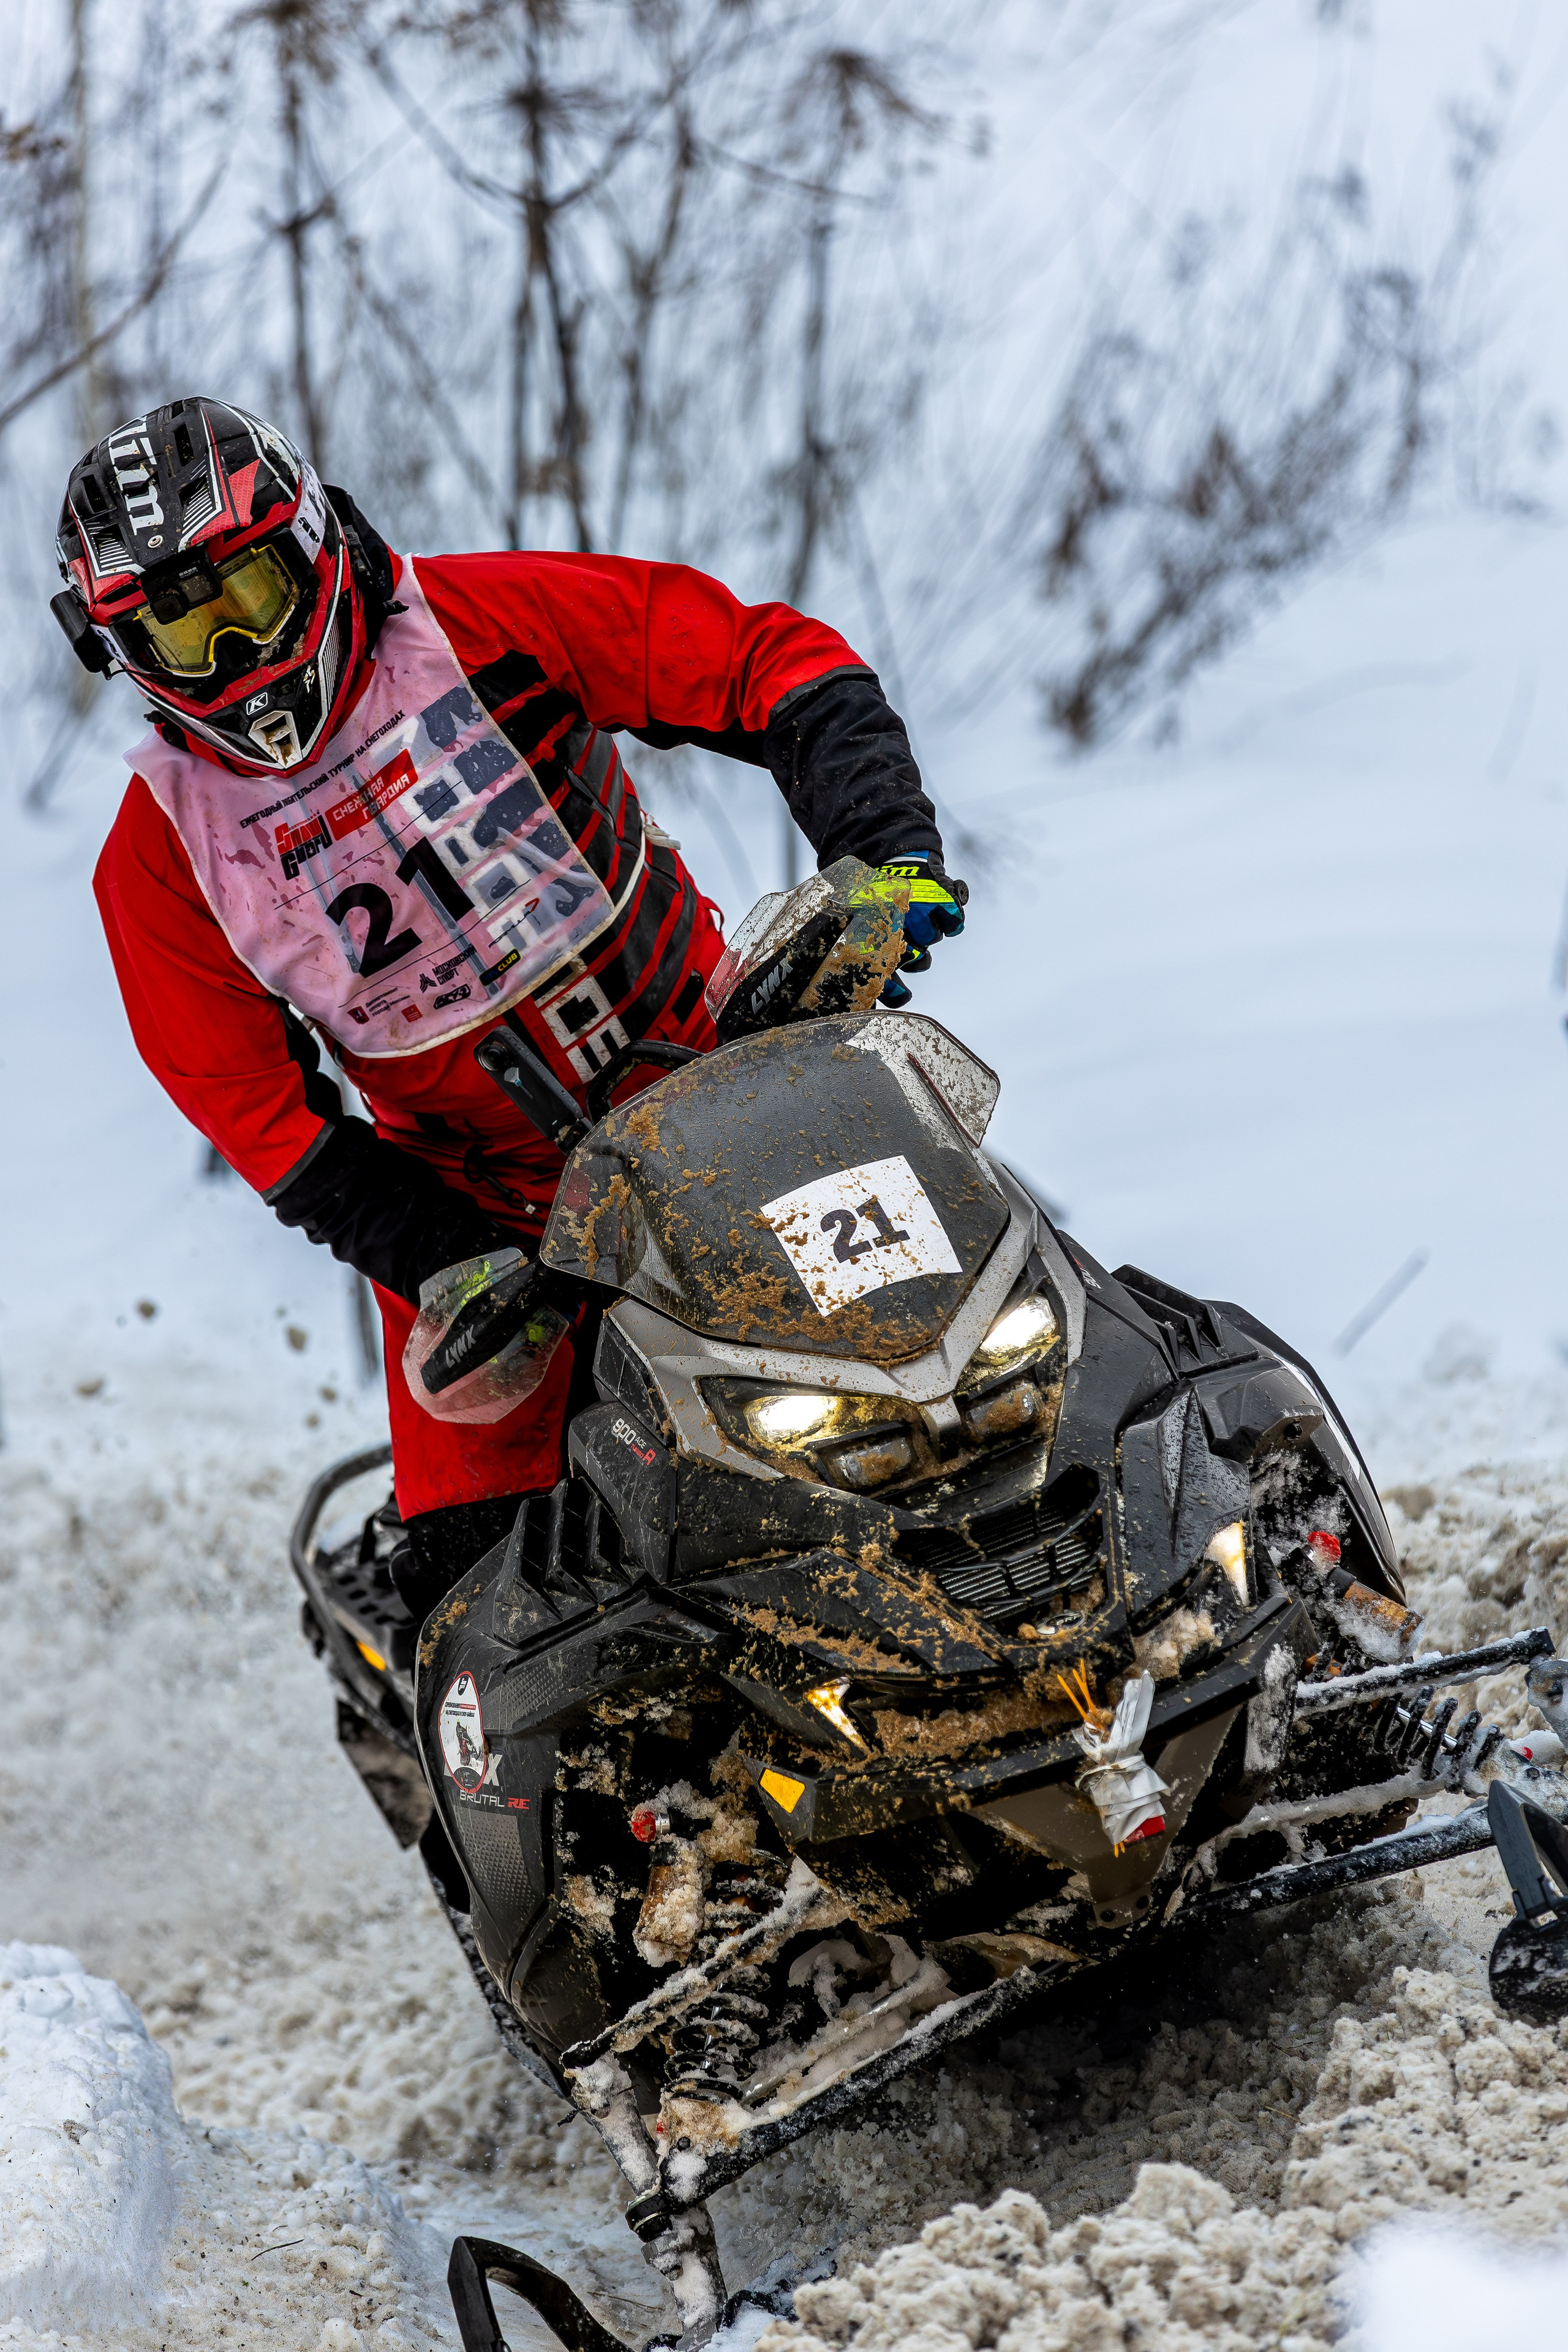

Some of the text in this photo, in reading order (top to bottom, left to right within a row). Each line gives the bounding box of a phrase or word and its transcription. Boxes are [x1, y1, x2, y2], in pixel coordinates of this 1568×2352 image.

[108, 416, 164, 537] lim
[248, 694, 266, 714] K
[239, 800, 284, 829] ЕЖЕГОДНЫЙ
[328, 753, 356, 780] ТУРНИР
[355, 745, 367, 758] НА
[364, 709, 406, 750] СНЕГОХОДАХ
[332, 776, 385, 821] СНЕЖНАЯ
[361, 773, 410, 820] ГВАРДИЯ
[325, 835, 475, 979] 21
[431, 943, 478, 977] МОСКОВСКИЙ
[436, 967, 459, 986] СПОРТ
[751, 954, 794, 1014] LYNX
[820, 1195, 911, 1264] 21
[445, 1324, 477, 1368] LYNX
[612, 1418, 647, 1449] 900 ACE
[630, 1443, 656, 1466] TURBO R
[459, 1789, 505, 1807] BRUTAL
